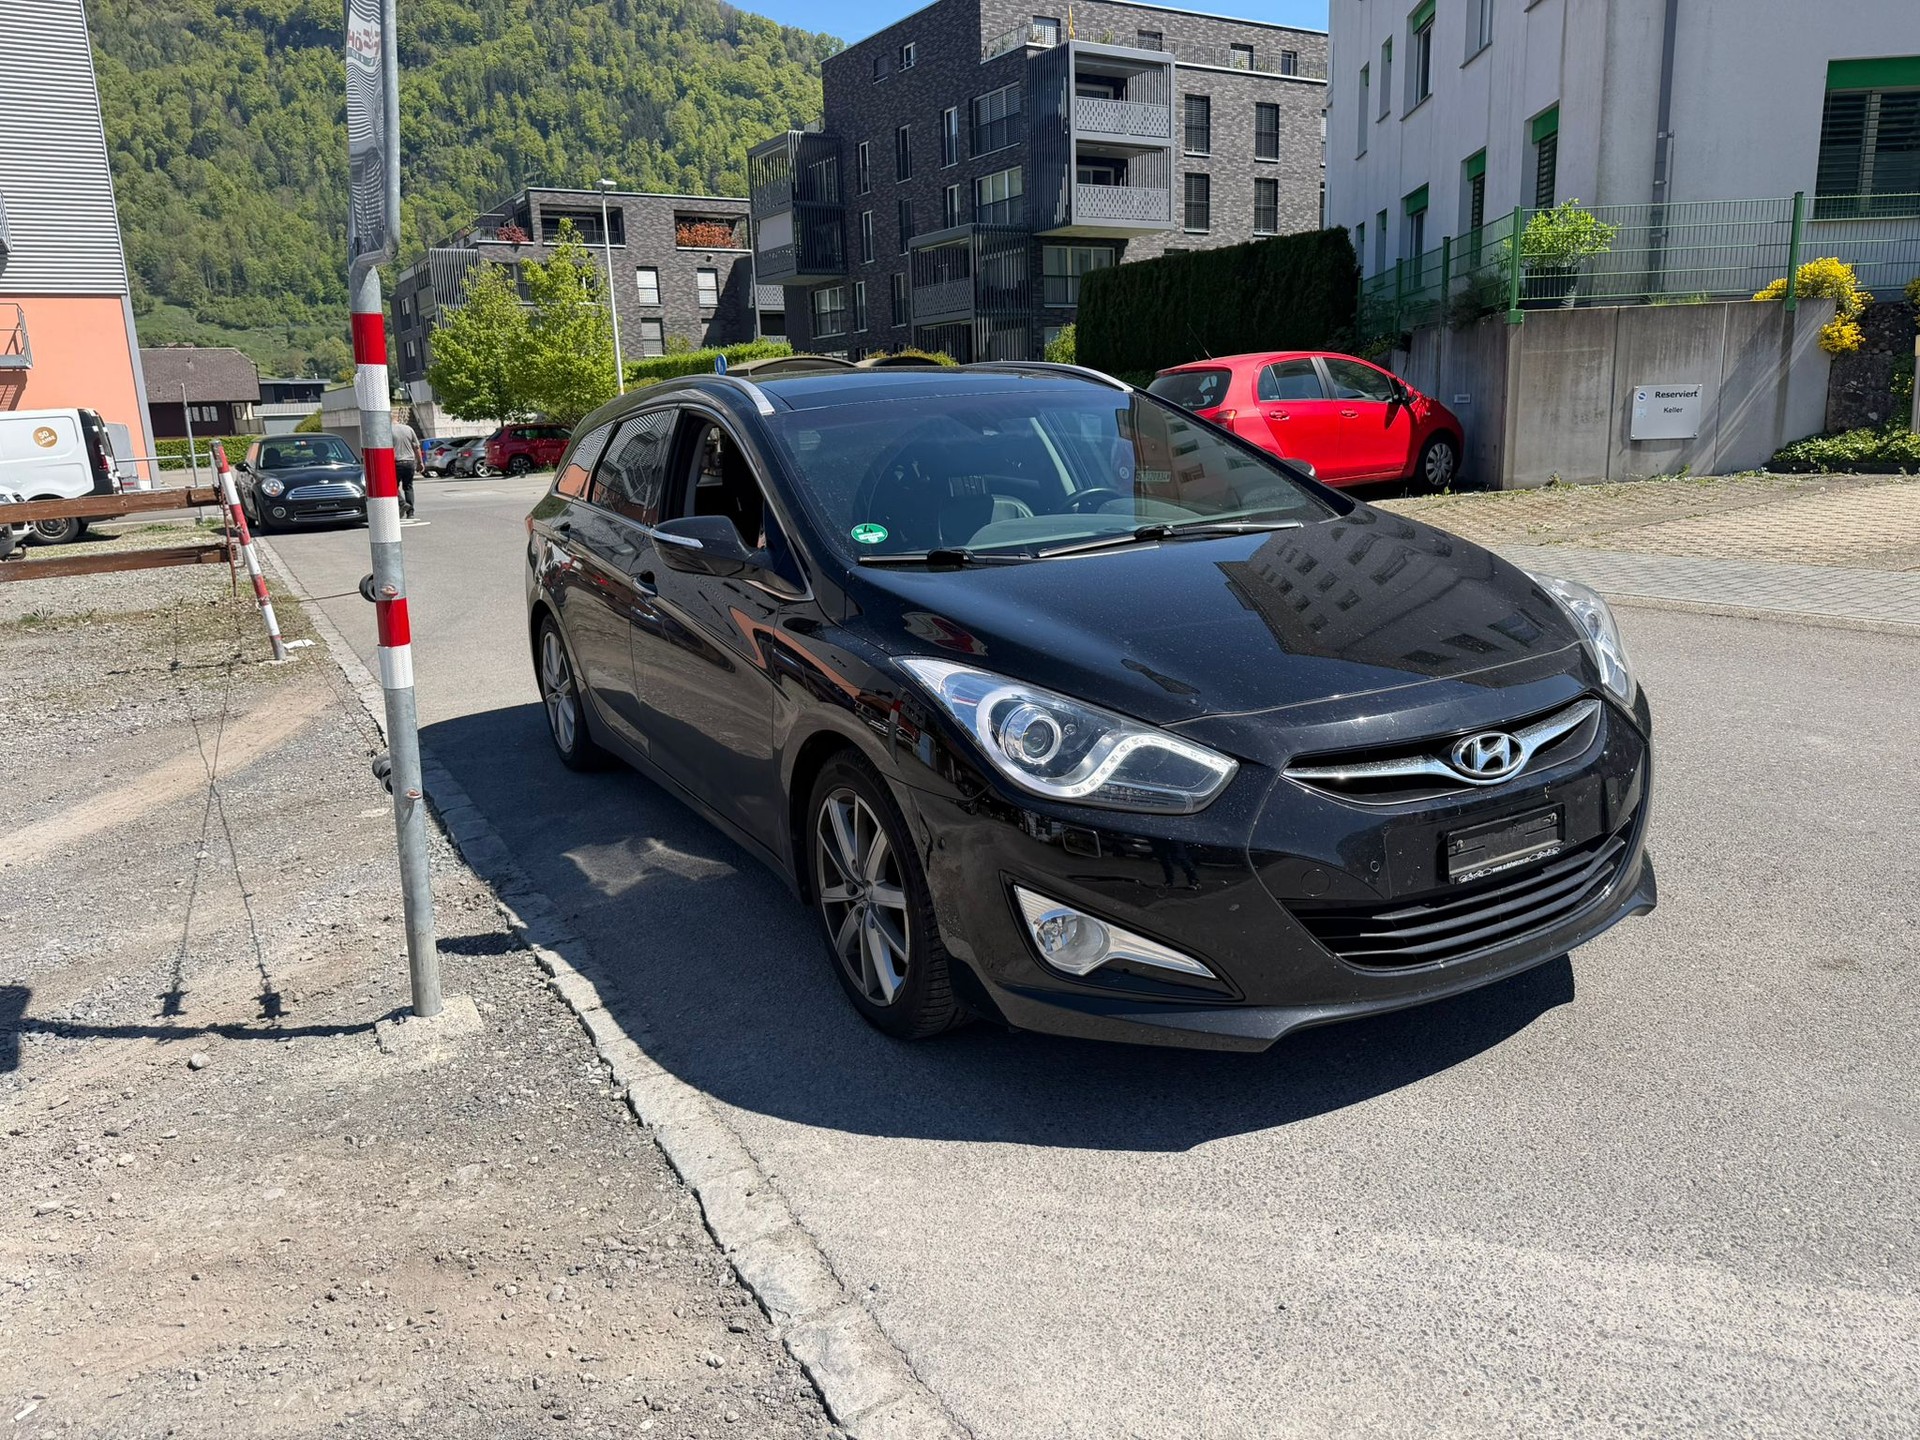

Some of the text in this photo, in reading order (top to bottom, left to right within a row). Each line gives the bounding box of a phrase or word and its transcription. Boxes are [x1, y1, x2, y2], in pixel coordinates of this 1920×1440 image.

[1655, 390, 1698, 399] Reserviert
[1663, 406, 1684, 414] Keller
[37, 430, 49, 440] 50
